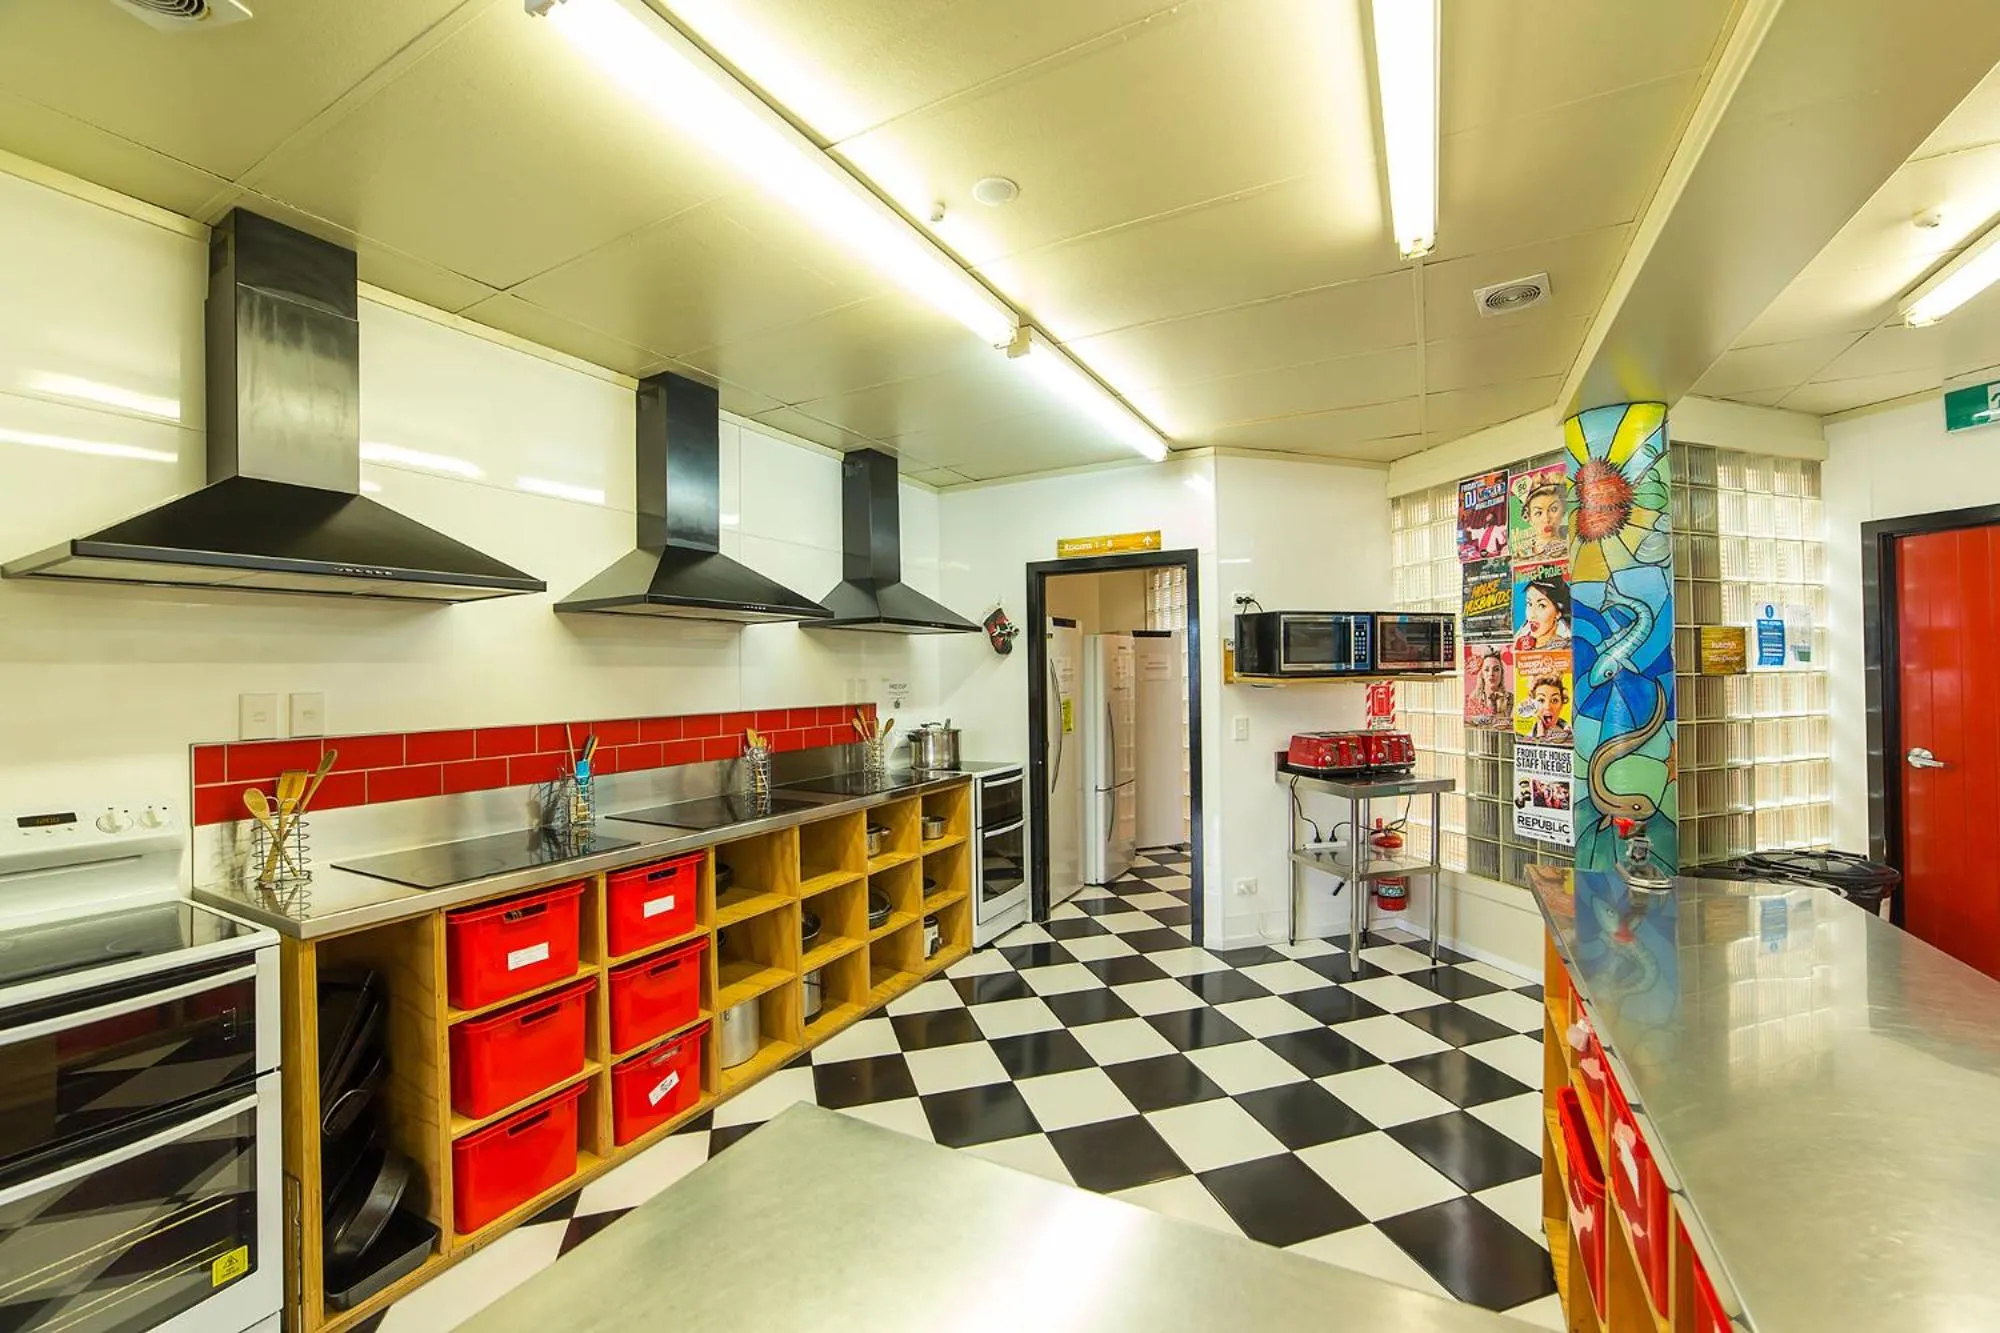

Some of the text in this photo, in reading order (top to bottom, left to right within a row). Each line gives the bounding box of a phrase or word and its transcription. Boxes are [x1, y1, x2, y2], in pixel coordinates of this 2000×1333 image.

[1464, 490, 1477, 508] DJ
[1516, 748, 1571, 762] FRONT OF HOUSE
[1516, 757, 1539, 769] STAFF
[1541, 760, 1571, 773] NEEDED
